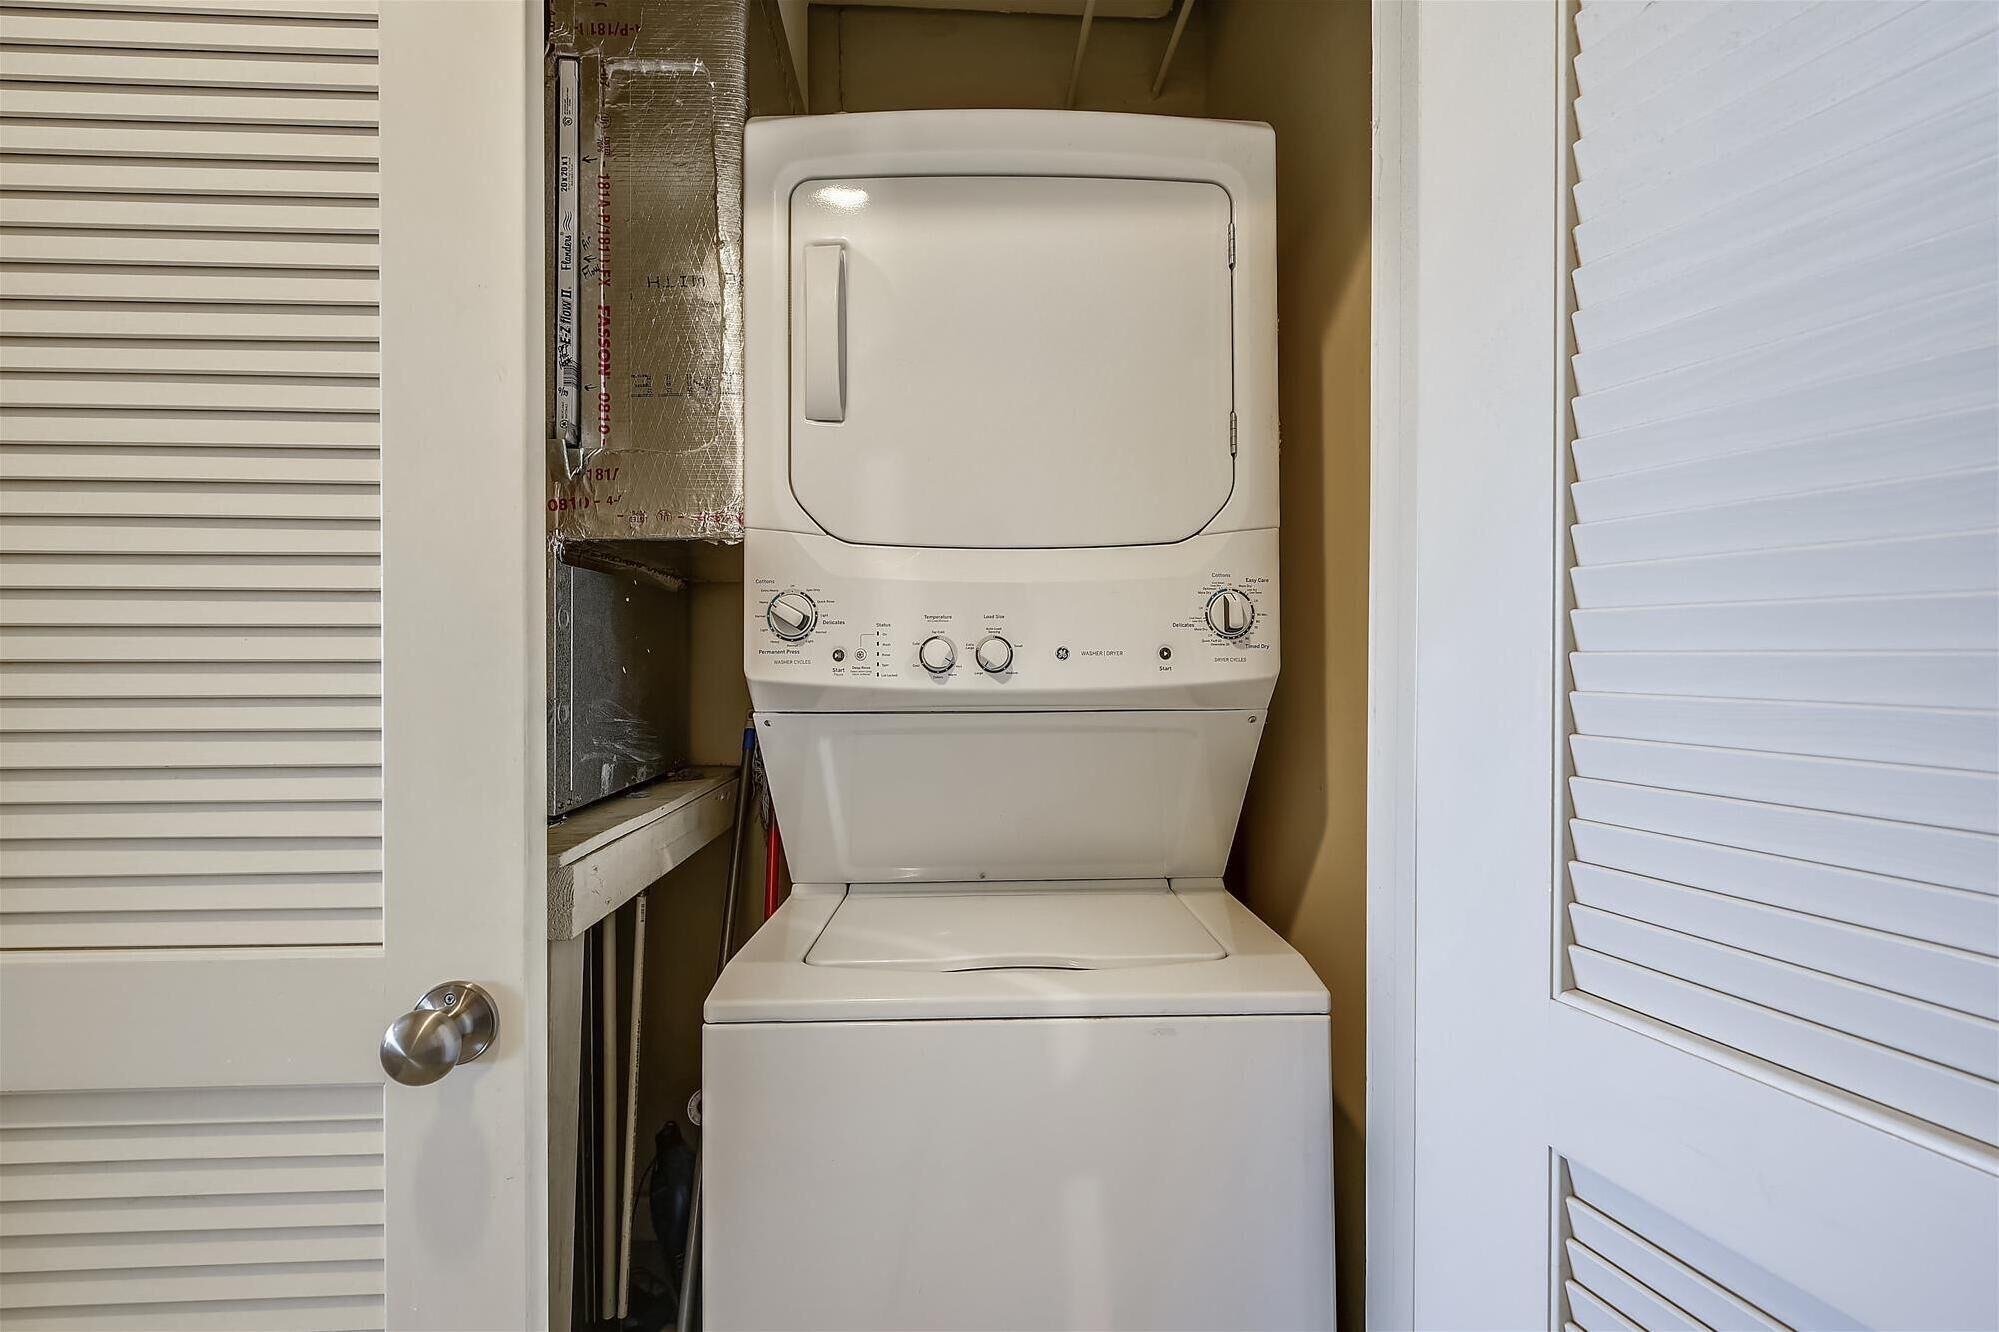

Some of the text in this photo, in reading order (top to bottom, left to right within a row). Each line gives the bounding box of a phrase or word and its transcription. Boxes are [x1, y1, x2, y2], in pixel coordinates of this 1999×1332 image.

[560, 235, 572, 271] Flanders
[561, 300, 571, 324] flow
[560, 326, 571, 345] E-Z
[598, 305, 611, 376] FASSON
[598, 393, 611, 434] 0810
